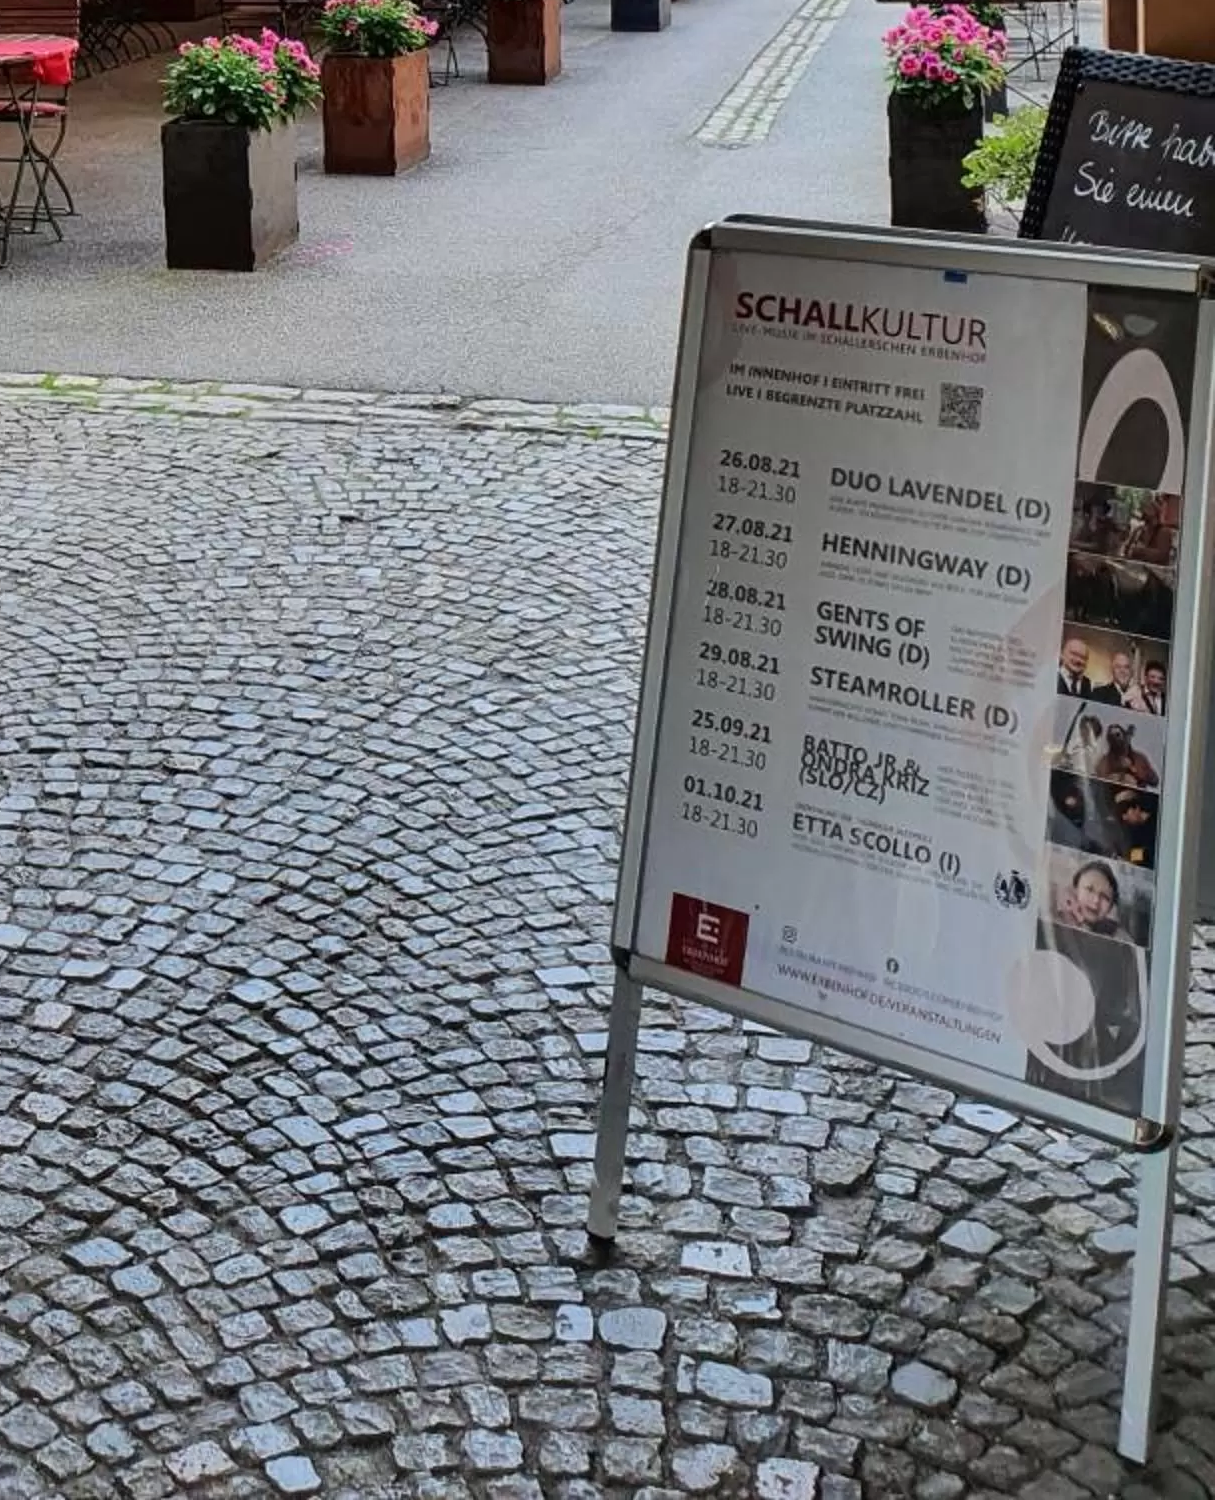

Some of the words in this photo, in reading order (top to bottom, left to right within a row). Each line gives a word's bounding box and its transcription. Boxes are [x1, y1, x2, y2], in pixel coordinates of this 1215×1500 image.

[1089, 109, 1154, 149] Bitte
[1074, 161, 1115, 203] Sie
[1126, 175, 1194, 217] einen
[735, 292, 986, 349] SCHALLKULTUR
[729, 363, 745, 376] IM
[748, 365, 820, 386] INNENHOF
[832, 377, 891, 397] EINTRITT
[895, 385, 926, 401] FREI
[726, 383, 754, 399] LIVE
[766, 389, 842, 413] BEGRENZTE
[845, 401, 923, 425] PLATZZAHL
[720, 449, 800, 479] 26.08.21
[718, 475, 797, 505] 18-21.30
[830, 467, 882, 493] DUO
[888, 476, 1009, 515] LAVENDEL
[1016, 496, 1051, 526] (D)
[712, 513, 794, 543] 27.08.21
[709, 539, 788, 570] 18-21.30
[821, 532, 989, 581] HENNINGWAY
[996, 563, 1032, 593] (D)
[706, 579, 786, 611] 28.08.21
[704, 605, 782, 637] 18-21.30
[816, 600, 890, 632] GENTS
[895, 616, 926, 639] OF
[698, 641, 780, 675] 29.08.21
[814, 625, 892, 659] SWING
[898, 642, 931, 671] (D)
[696, 668, 775, 701] 18-21.30
[809, 665, 976, 721] STEAMROLLER
[985, 704, 1019, 735] (D)
[691, 709, 773, 745] 25.09.21
[688, 735, 767, 771] 18-21.30
[801, 750, 876, 785] ONDRA
[684, 775, 764, 812] 01.10.21
[799, 766, 886, 805] (SLO/CZ)
[681, 802, 759, 839] 18-21.30
[792, 812, 844, 841] ETTA
[849, 827, 932, 864] SCOLLO
